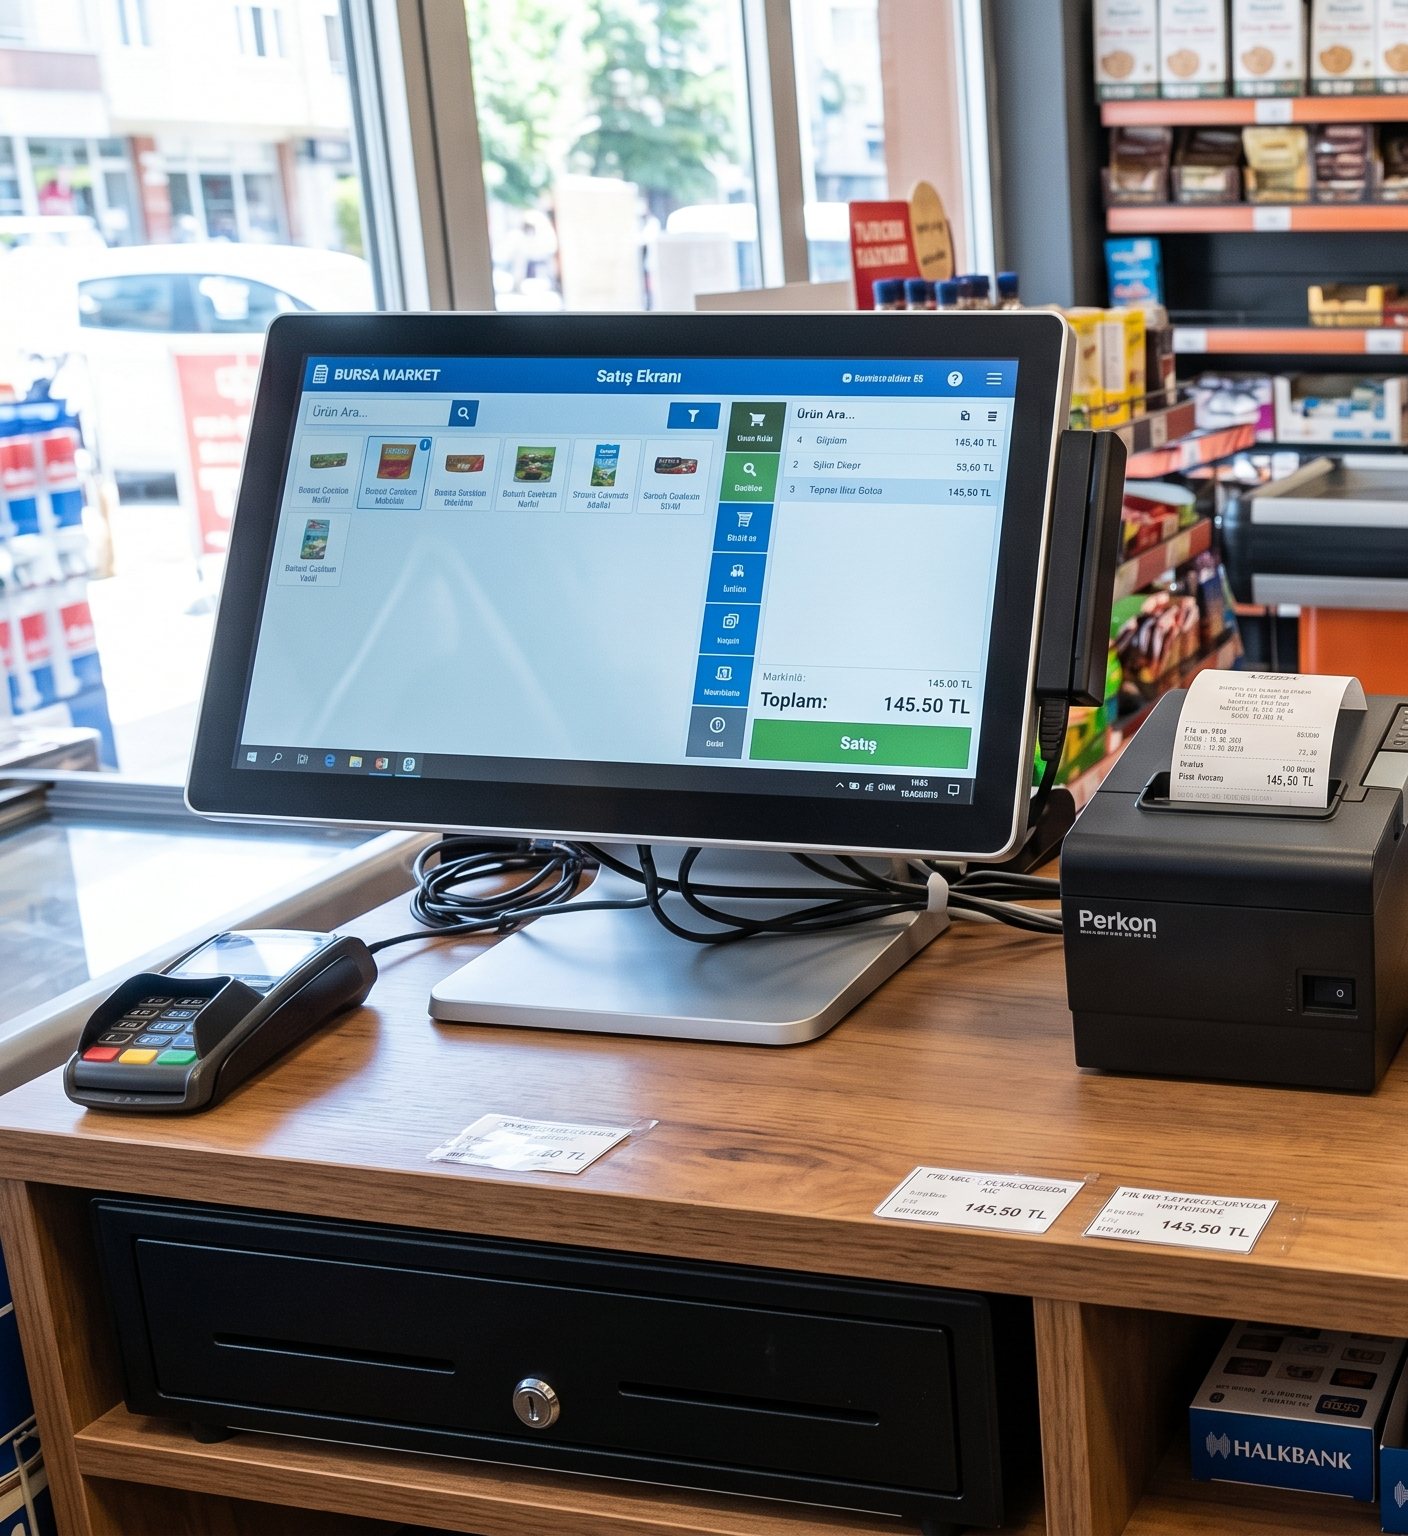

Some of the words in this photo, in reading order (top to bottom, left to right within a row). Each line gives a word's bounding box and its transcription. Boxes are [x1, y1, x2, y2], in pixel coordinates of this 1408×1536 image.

[333, 367, 380, 382] BURSA
[382, 368, 441, 382] MARKET
[596, 369, 633, 387] Satış
[636, 369, 682, 385] Ekranı
[312, 403, 338, 419] Ürün
[340, 406, 369, 419] Ara...
[797, 407, 823, 419] Ürün
[826, 409, 855, 420] Ara...
[796, 436, 803, 444] 4
[954, 438, 984, 448] 145,40
[986, 438, 997, 447] TL
[792, 460, 799, 469] 2
[956, 463, 981, 473] 53,60
[983, 463, 994, 472] TL
[789, 485, 795, 494] 3
[948, 488, 978, 497] 145,50
[981, 489, 992, 497] TL
[928, 679, 959, 689] 145.00
[961, 680, 973, 689] TL
[760, 692, 828, 712] Toplam:
[884, 696, 944, 714] 145.50
[948, 698, 971, 714] TL
[840, 735, 878, 755] Satış
[1266, 774, 1298, 787] 145,50
[1303, 775, 1314, 787] TL
[1079, 909, 1157, 933] Perkon
[566, 1150, 586, 1161] TL
[1028, 1208, 1048, 1220] TL
[1228, 1226, 1250, 1239] TL
[1233, 1438, 1353, 1471] HALKBANK
